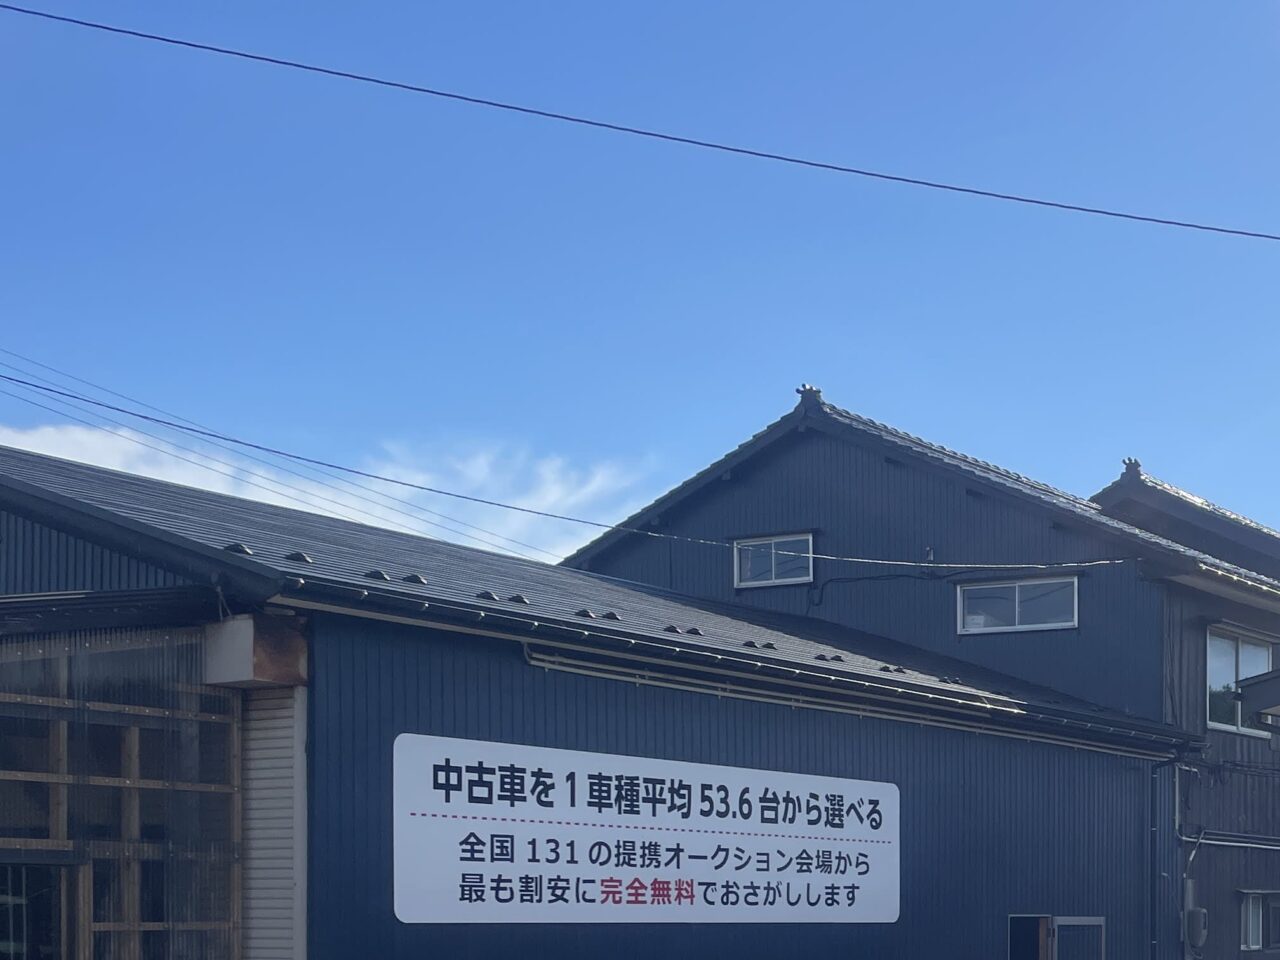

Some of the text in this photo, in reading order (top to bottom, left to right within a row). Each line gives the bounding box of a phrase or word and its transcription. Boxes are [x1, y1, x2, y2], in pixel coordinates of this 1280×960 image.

[458, 873, 861, 907] 最も割安に完全無料でおさがしします
